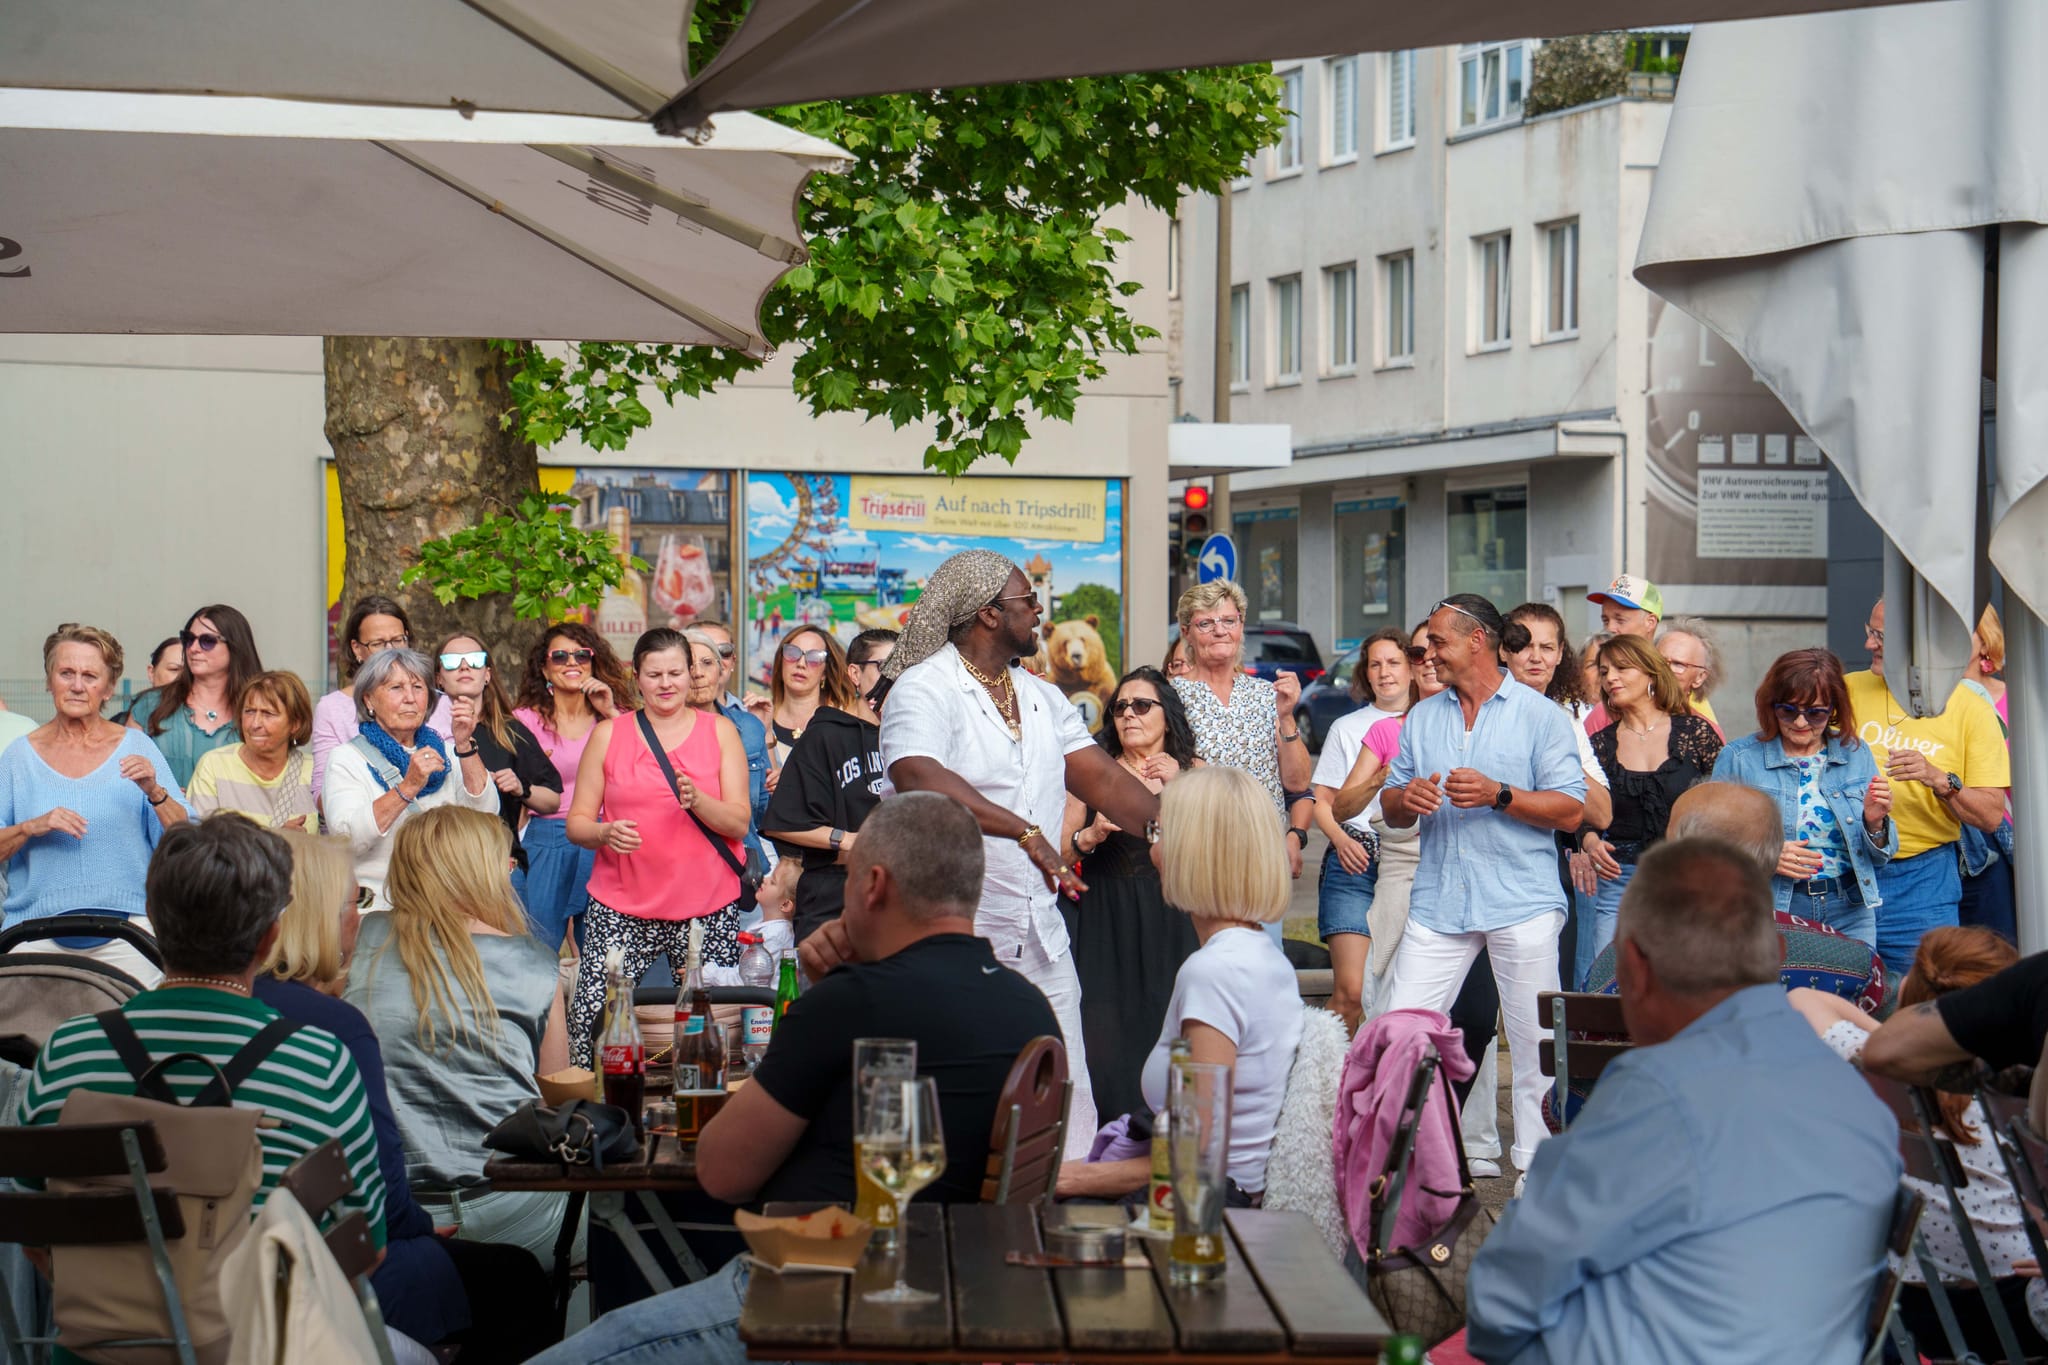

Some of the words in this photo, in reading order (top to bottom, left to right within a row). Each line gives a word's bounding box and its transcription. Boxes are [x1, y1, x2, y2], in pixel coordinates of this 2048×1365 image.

[1702, 476, 1722, 486] VHV
[1725, 475, 1811, 488] Autoversicherung:
[1702, 490, 1718, 500] Zur
[1721, 490, 1740, 500] VHV
[1743, 490, 1788, 500] wechseln
[1791, 490, 1808, 500] und
[860, 497, 926, 519] Tripsdrill
[935, 495, 968, 512] Auf
[971, 498, 1011, 515] nach
[1016, 500, 1097, 520] Tripsdrill!
[1860, 720, 1944, 757] Oliver
